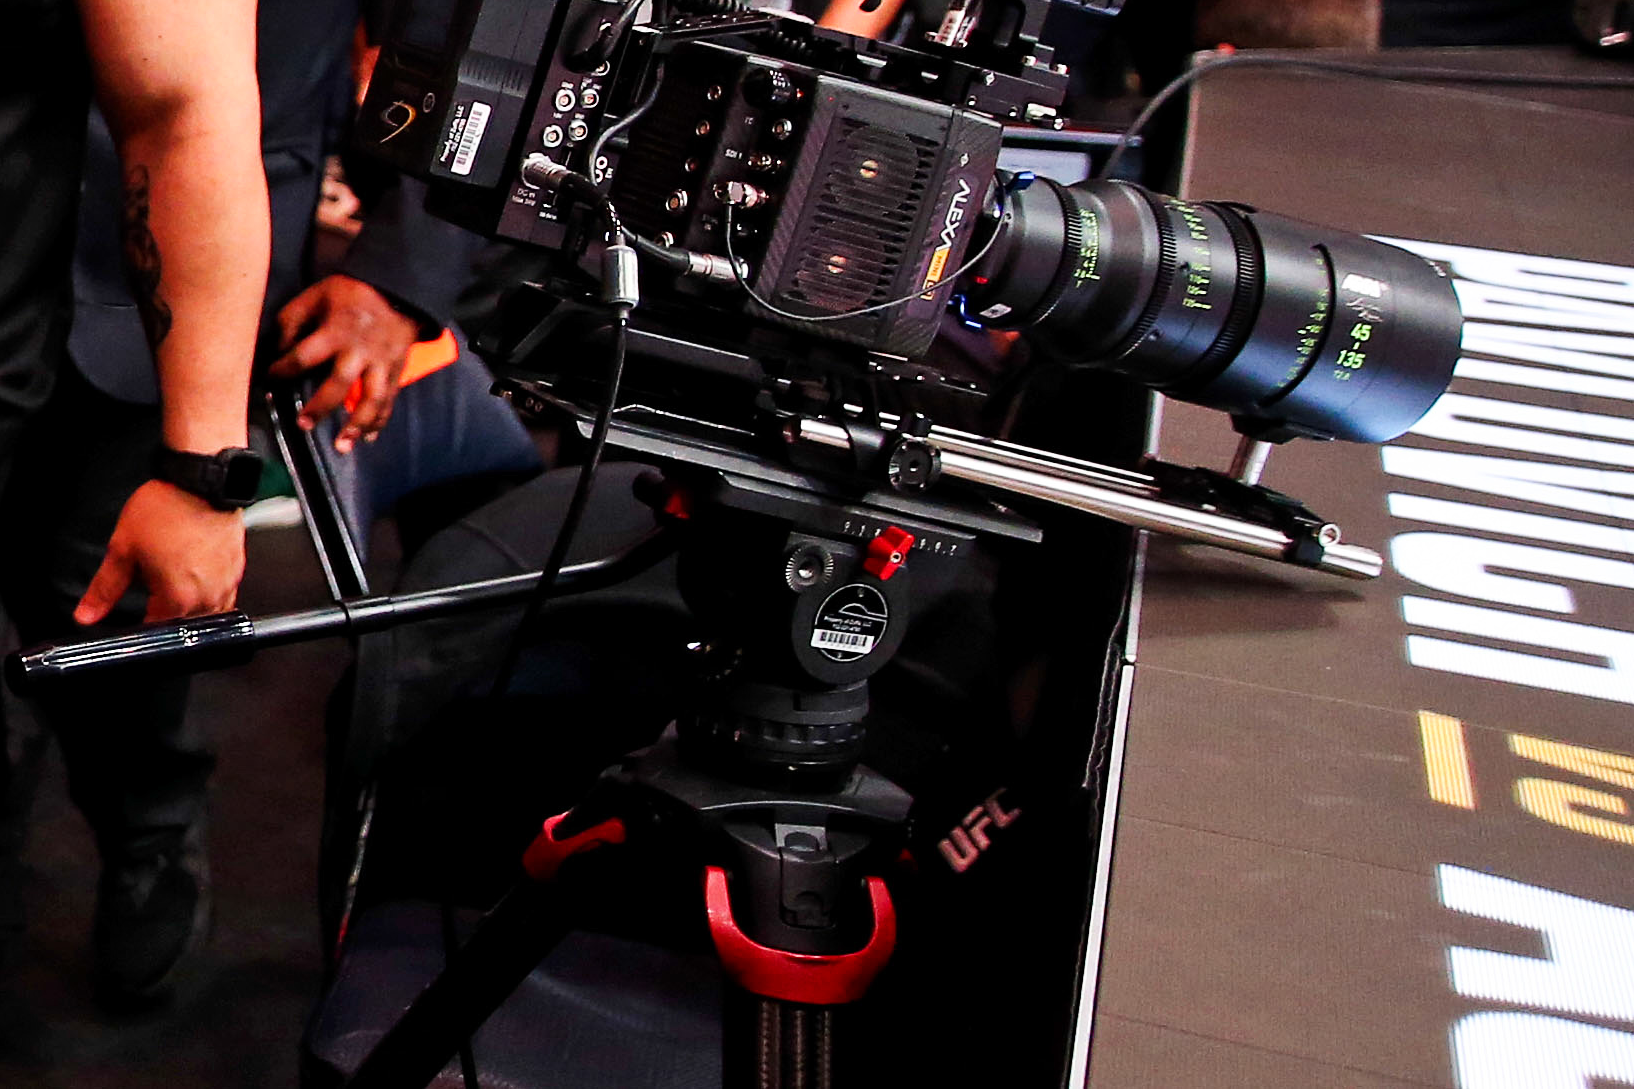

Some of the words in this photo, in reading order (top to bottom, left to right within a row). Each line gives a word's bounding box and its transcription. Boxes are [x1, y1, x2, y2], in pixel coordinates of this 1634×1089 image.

[935, 178, 971, 251] ALEXA
[1350, 323, 1373, 341] 45
[1336, 349, 1366, 369] 135
[937, 788, 1022, 873] UFC
